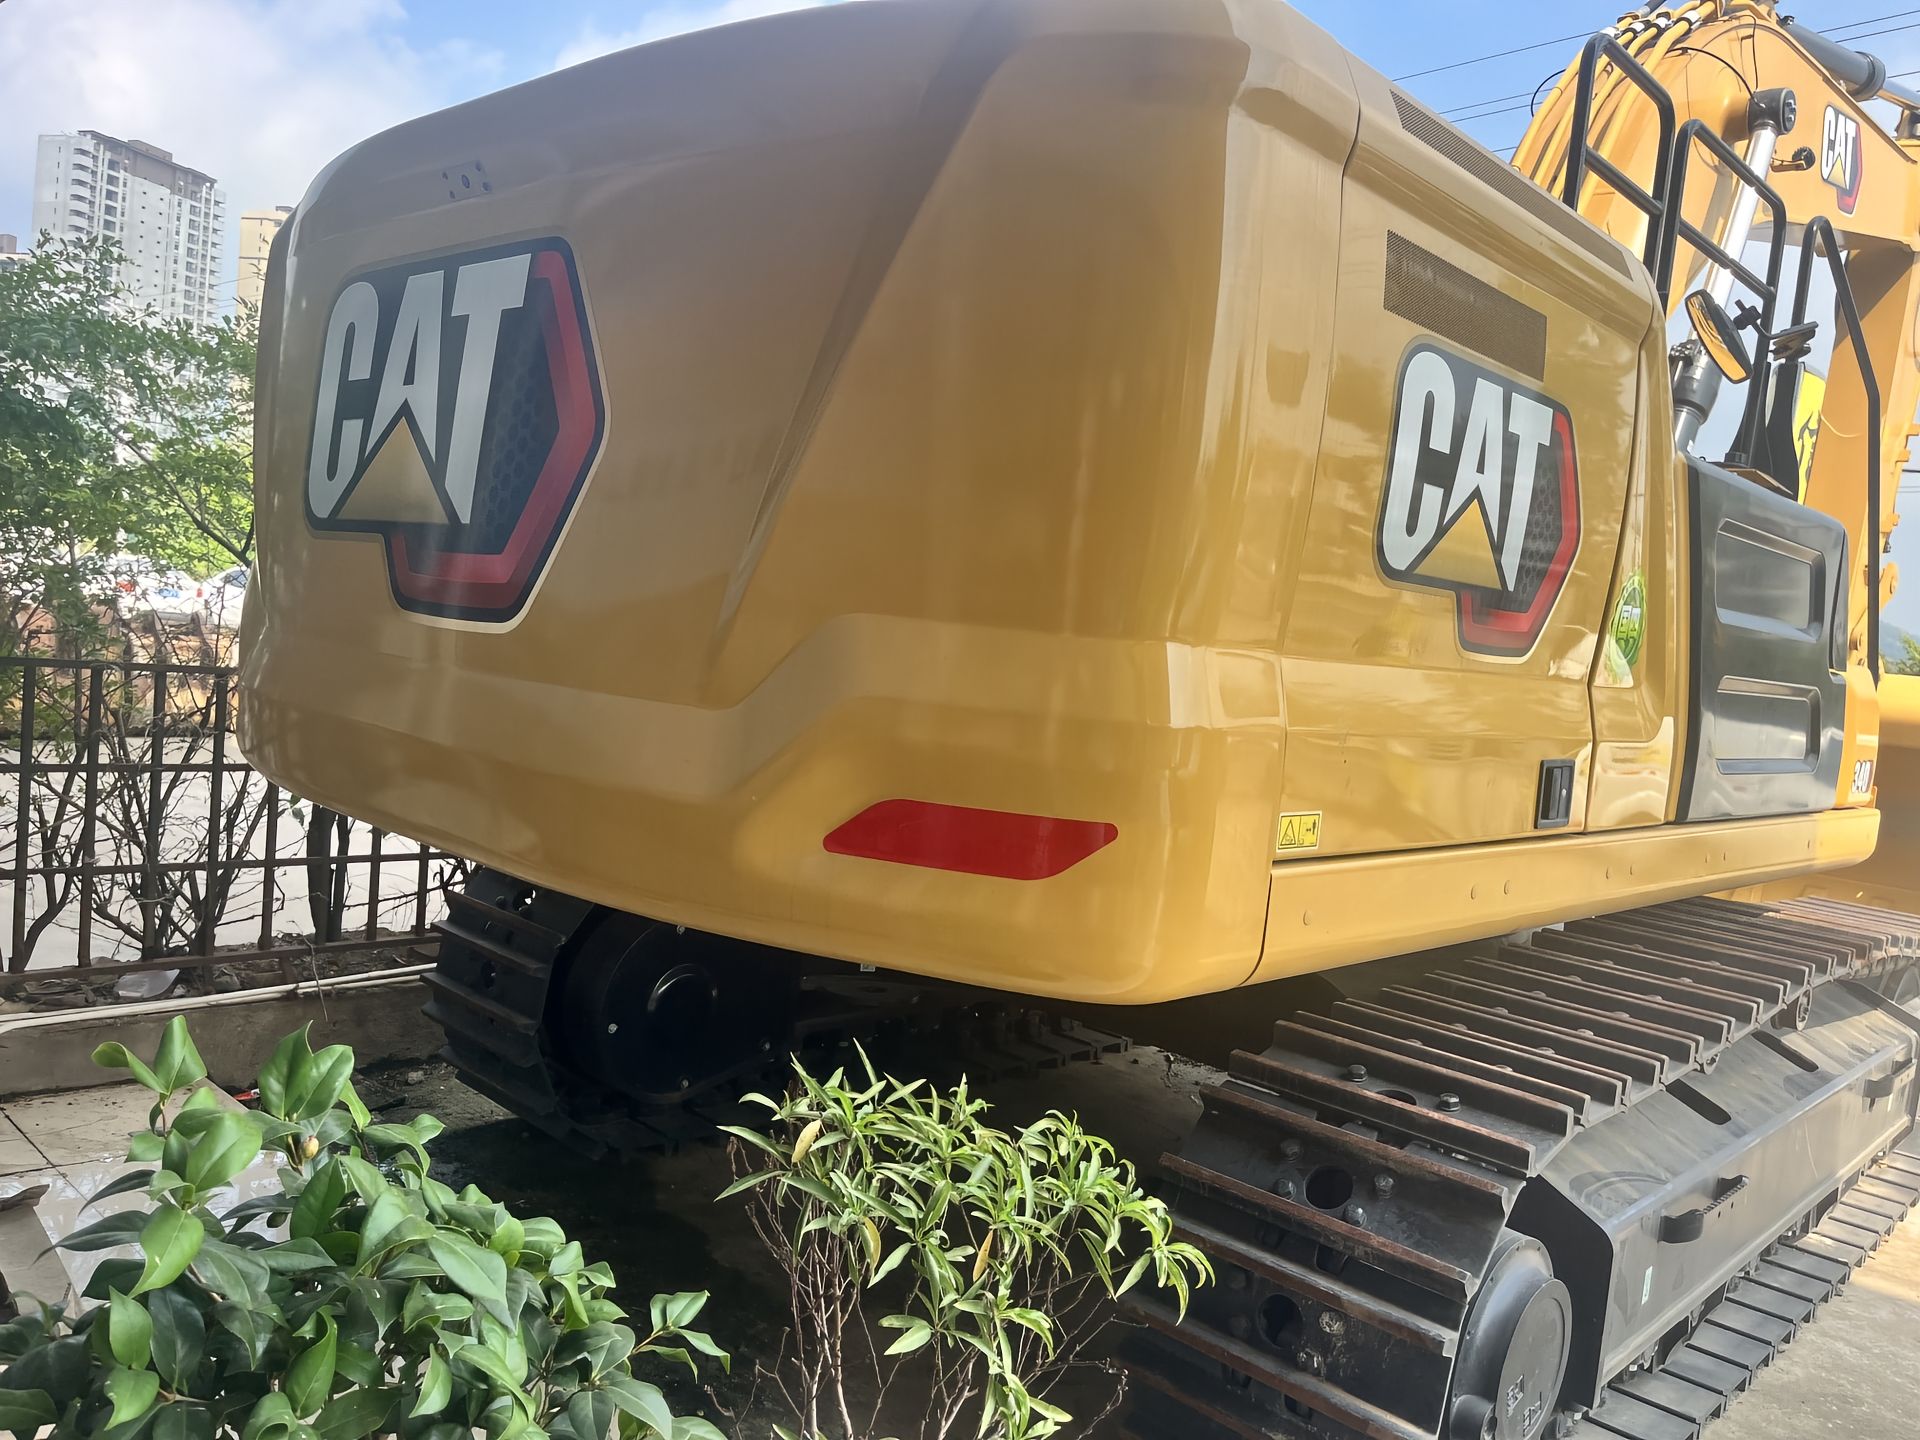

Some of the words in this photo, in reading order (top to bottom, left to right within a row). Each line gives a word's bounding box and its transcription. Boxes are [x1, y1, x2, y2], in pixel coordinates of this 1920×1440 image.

[1822, 105, 1856, 190] CAT
[308, 253, 531, 524] CAT
[1382, 351, 1553, 591] CAT
[1852, 761, 1871, 793] 340
